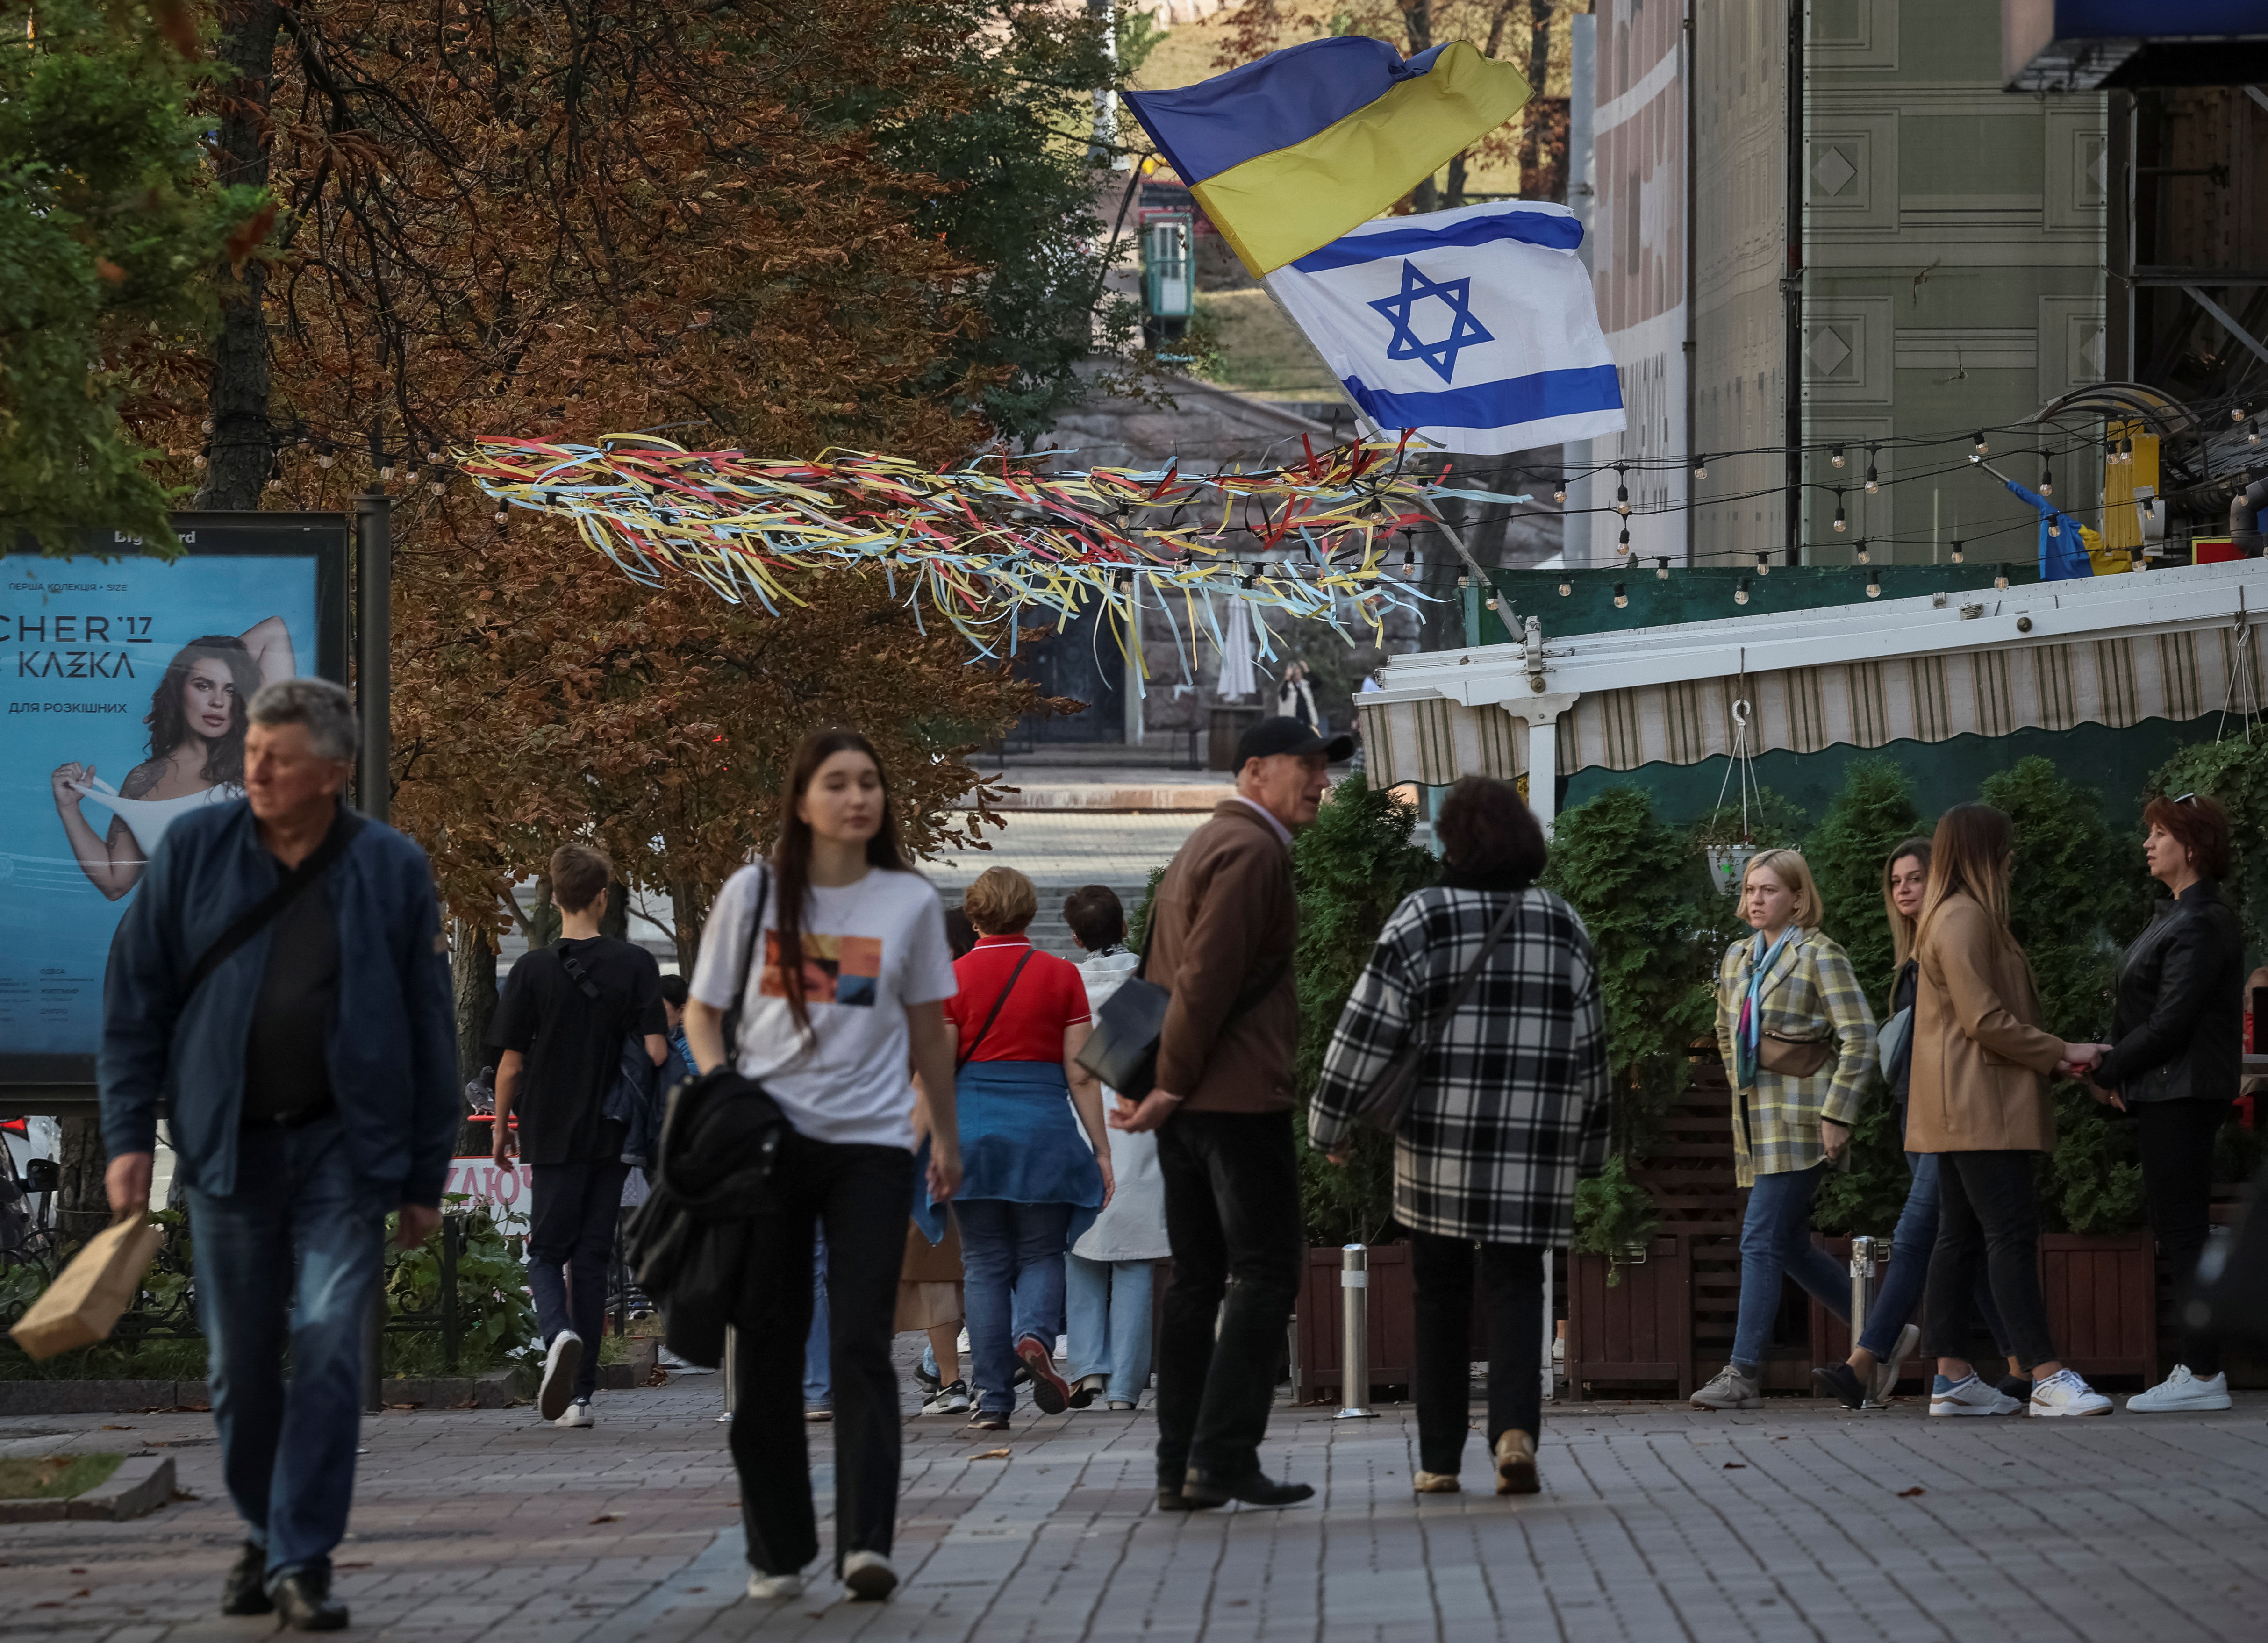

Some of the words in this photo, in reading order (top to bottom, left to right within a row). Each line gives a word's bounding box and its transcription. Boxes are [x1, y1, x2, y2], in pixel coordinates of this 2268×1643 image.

[114, 531, 196, 546] Bigrd
[48, 583, 97, 592] КОЛЕКЦІЯ
[9, 702, 39, 714] ДЛЯ
[44, 703, 127, 714] РОЗКІШНИХ
